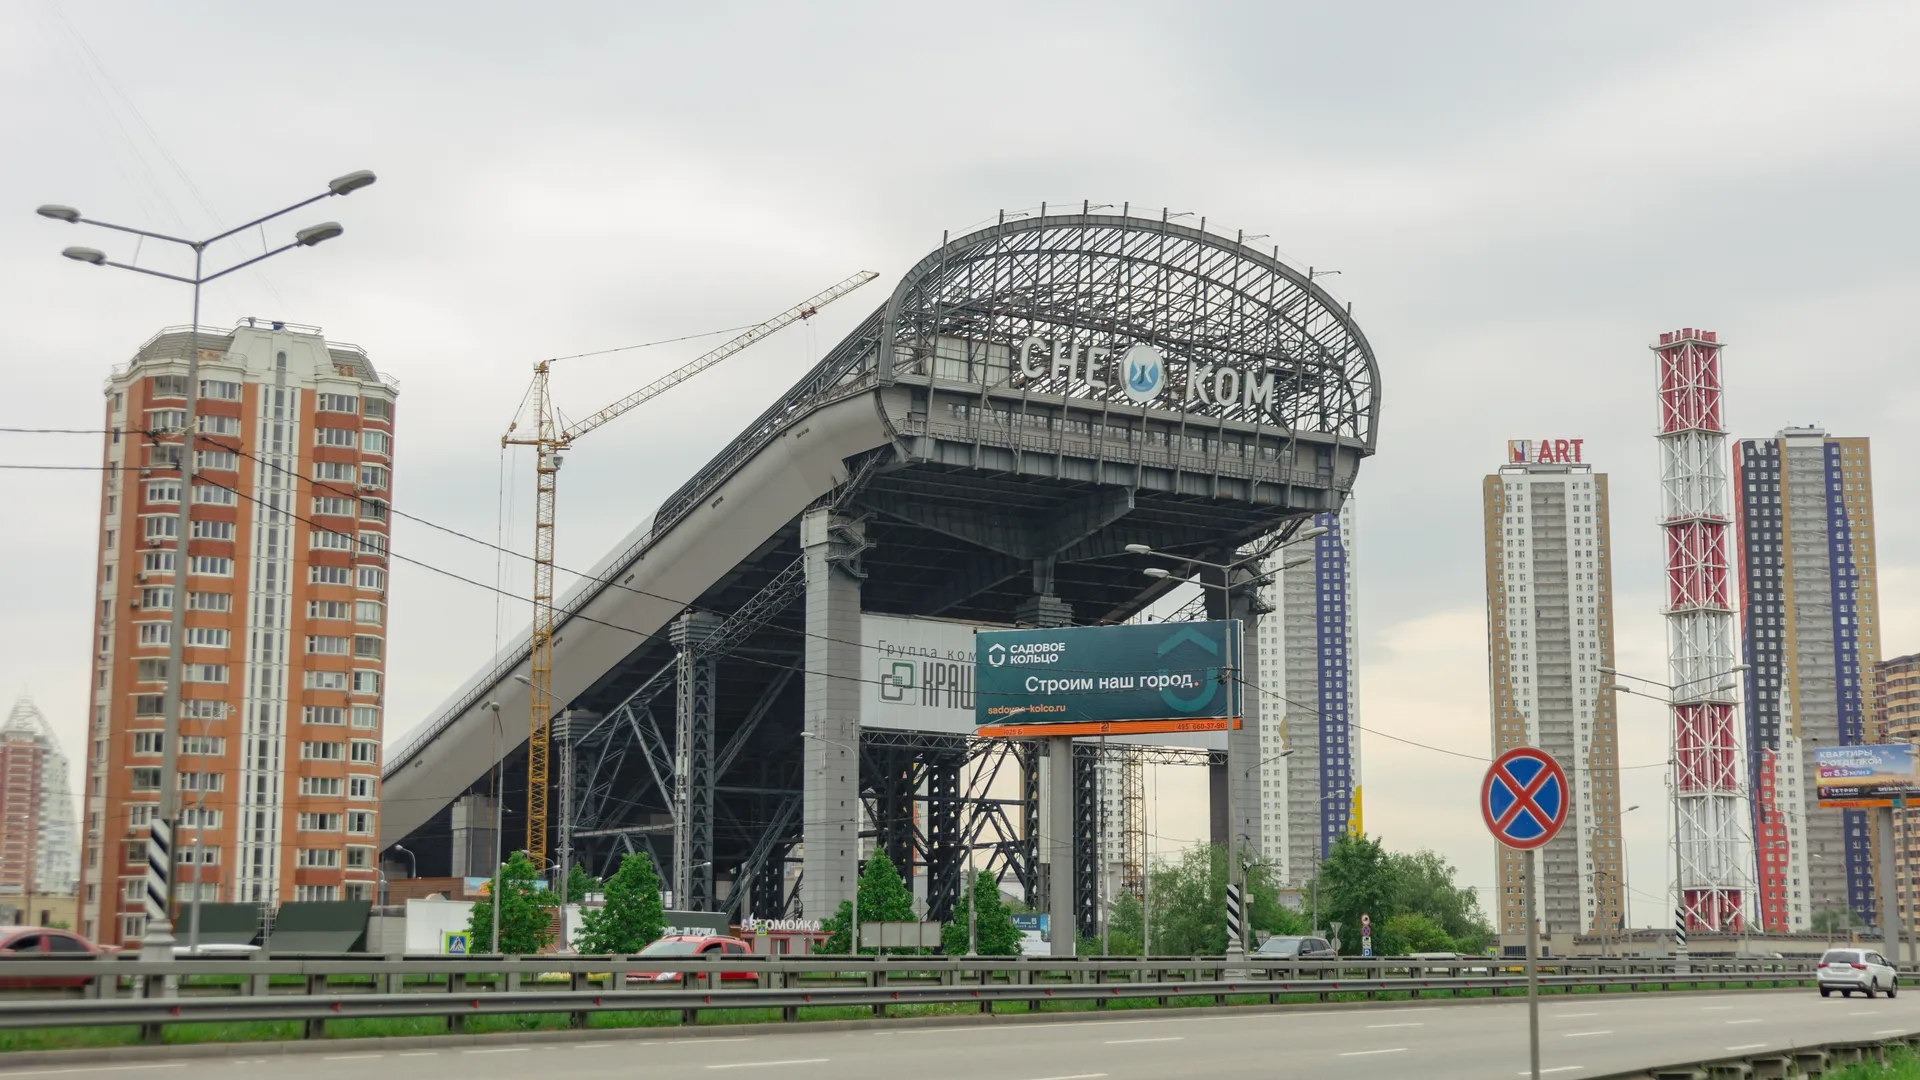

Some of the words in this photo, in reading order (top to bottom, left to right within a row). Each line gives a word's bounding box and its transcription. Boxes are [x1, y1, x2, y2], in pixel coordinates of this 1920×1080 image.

[1537, 439, 1584, 463] ART
[878, 639, 937, 659] Группа
[1010, 642, 1066, 654] САДОВОЕ
[1010, 653, 1059, 664] КОЛЬЦО
[1025, 676, 1093, 695] Строим
[1099, 676, 1134, 690] наш
[1139, 673, 1199, 691] город.
[1192, 722, 1225, 730] 660-37-90
[1819, 749, 1873, 759] КВАРТИРЫ
[1829, 757, 1882, 767] ОТДЕЛКОЙ
